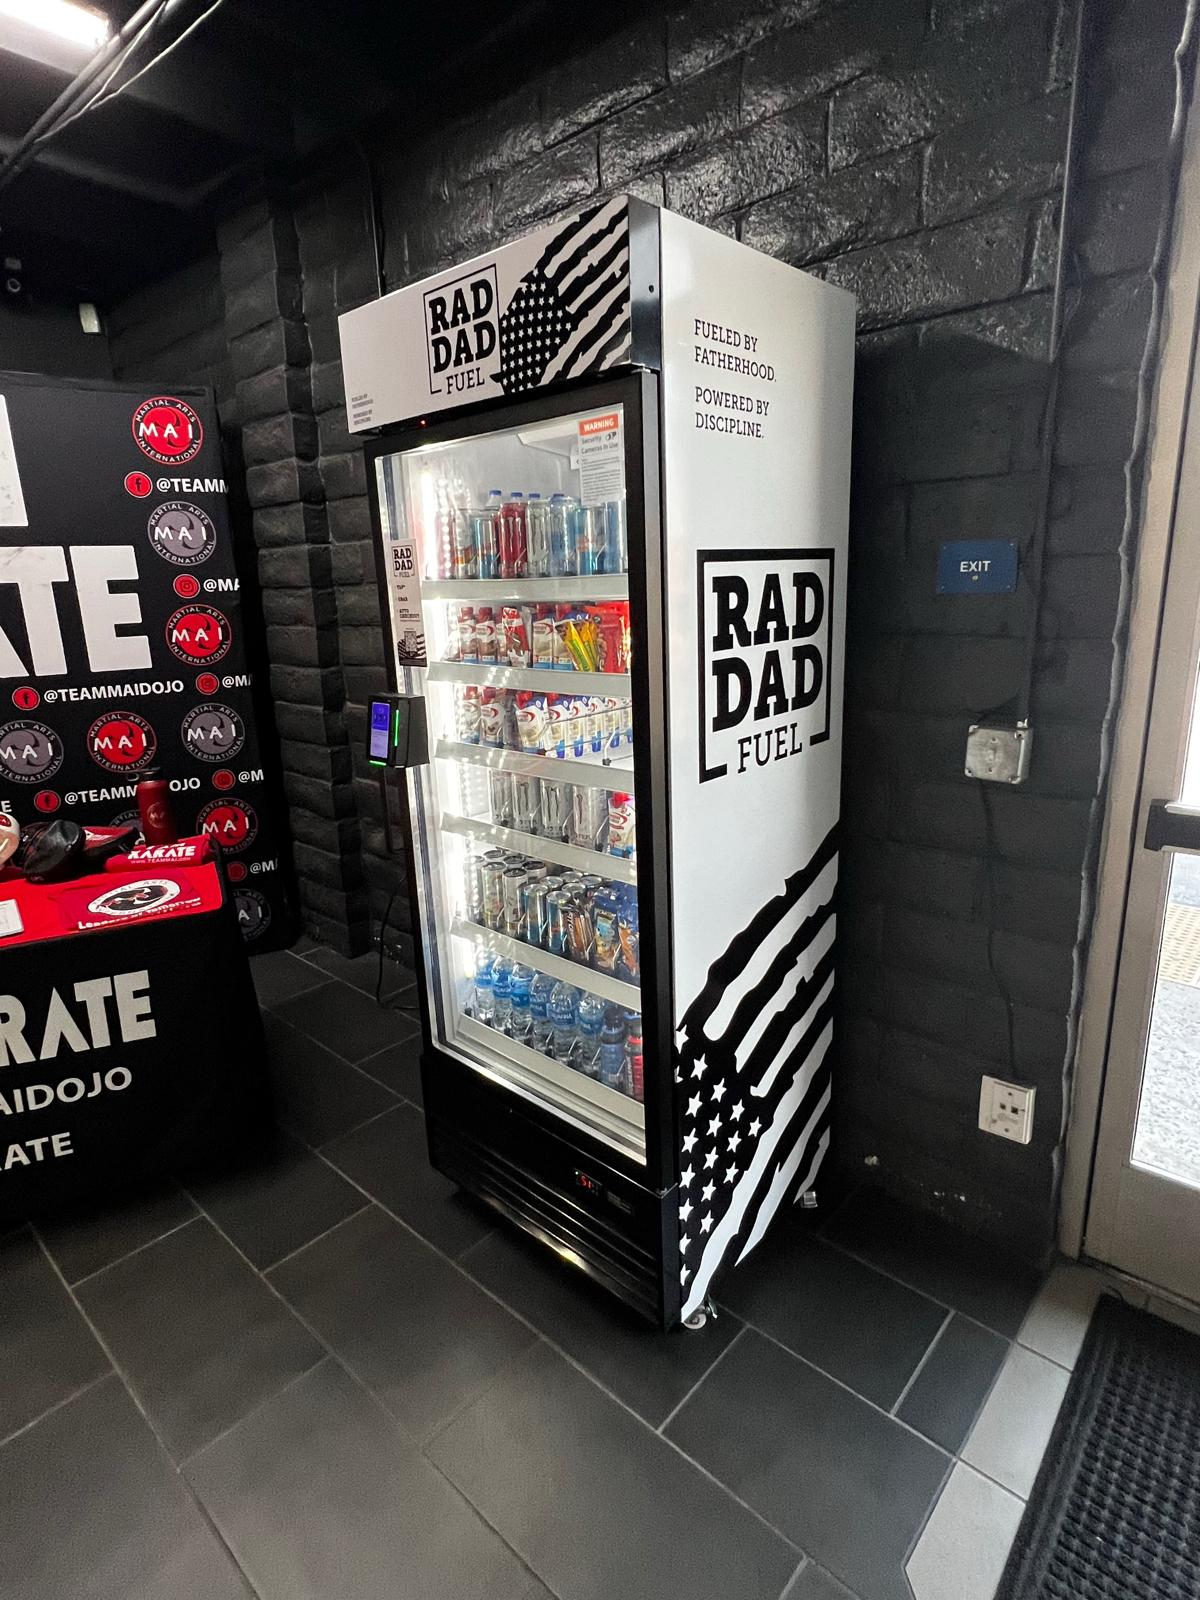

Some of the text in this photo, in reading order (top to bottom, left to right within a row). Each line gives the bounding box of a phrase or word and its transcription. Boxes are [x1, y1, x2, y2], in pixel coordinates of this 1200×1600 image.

[429, 279, 493, 336] RAD
[694, 319, 758, 352] FUELED BY
[431, 321, 496, 374] DAD
[694, 346, 777, 382] FATHERHOOD.
[446, 367, 486, 395] FUEL
[135, 400, 196, 423] MARTIAL ARTS
[695, 386, 770, 416] POWERED BY
[138, 422, 193, 439] MAI
[583, 418, 614, 432] WARNING
[696, 412, 764, 439] DISCIPLINE.
[138, 438, 201, 462] INTERNATIONAL
[151, 504, 208, 526] MARTIAL ARTS
[154, 526, 207, 541] MAI
[153, 540, 215, 564] INTERNATIONAL
[393, 548, 412, 560] RAD
[394, 559, 413, 571] DAD
[960, 560, 991, 573] EXIT
[168, 606, 225, 629] MARTIAL ARTS
[712, 572, 825, 652] RAD
[172, 627, 223, 643] MAI
[170, 639, 230, 663] INTERNATIONAL
[44, 680, 184, 703] @TEAMMAIDOJO
[712, 644, 823, 733] DAD
[90, 713, 150, 737] MARTIAL ARTS
[184, 705, 238, 728] MARTIAL ARTS
[33, 724, 55, 740] ARTS
[94, 733, 147, 751] MAI
[187, 723, 236, 742] MAI
[94, 745, 155, 771] INTERNATIONAL
[186, 736, 244, 760] INTERNATIONAL
[737, 722, 803, 774] FUEL
[238, 769, 264, 783] @M
[202, 816, 249, 835] MAI
[127, 844, 197, 860] KARATE
[238, 905, 262, 921] AI
[0, 1131, 74, 1171] ATE
